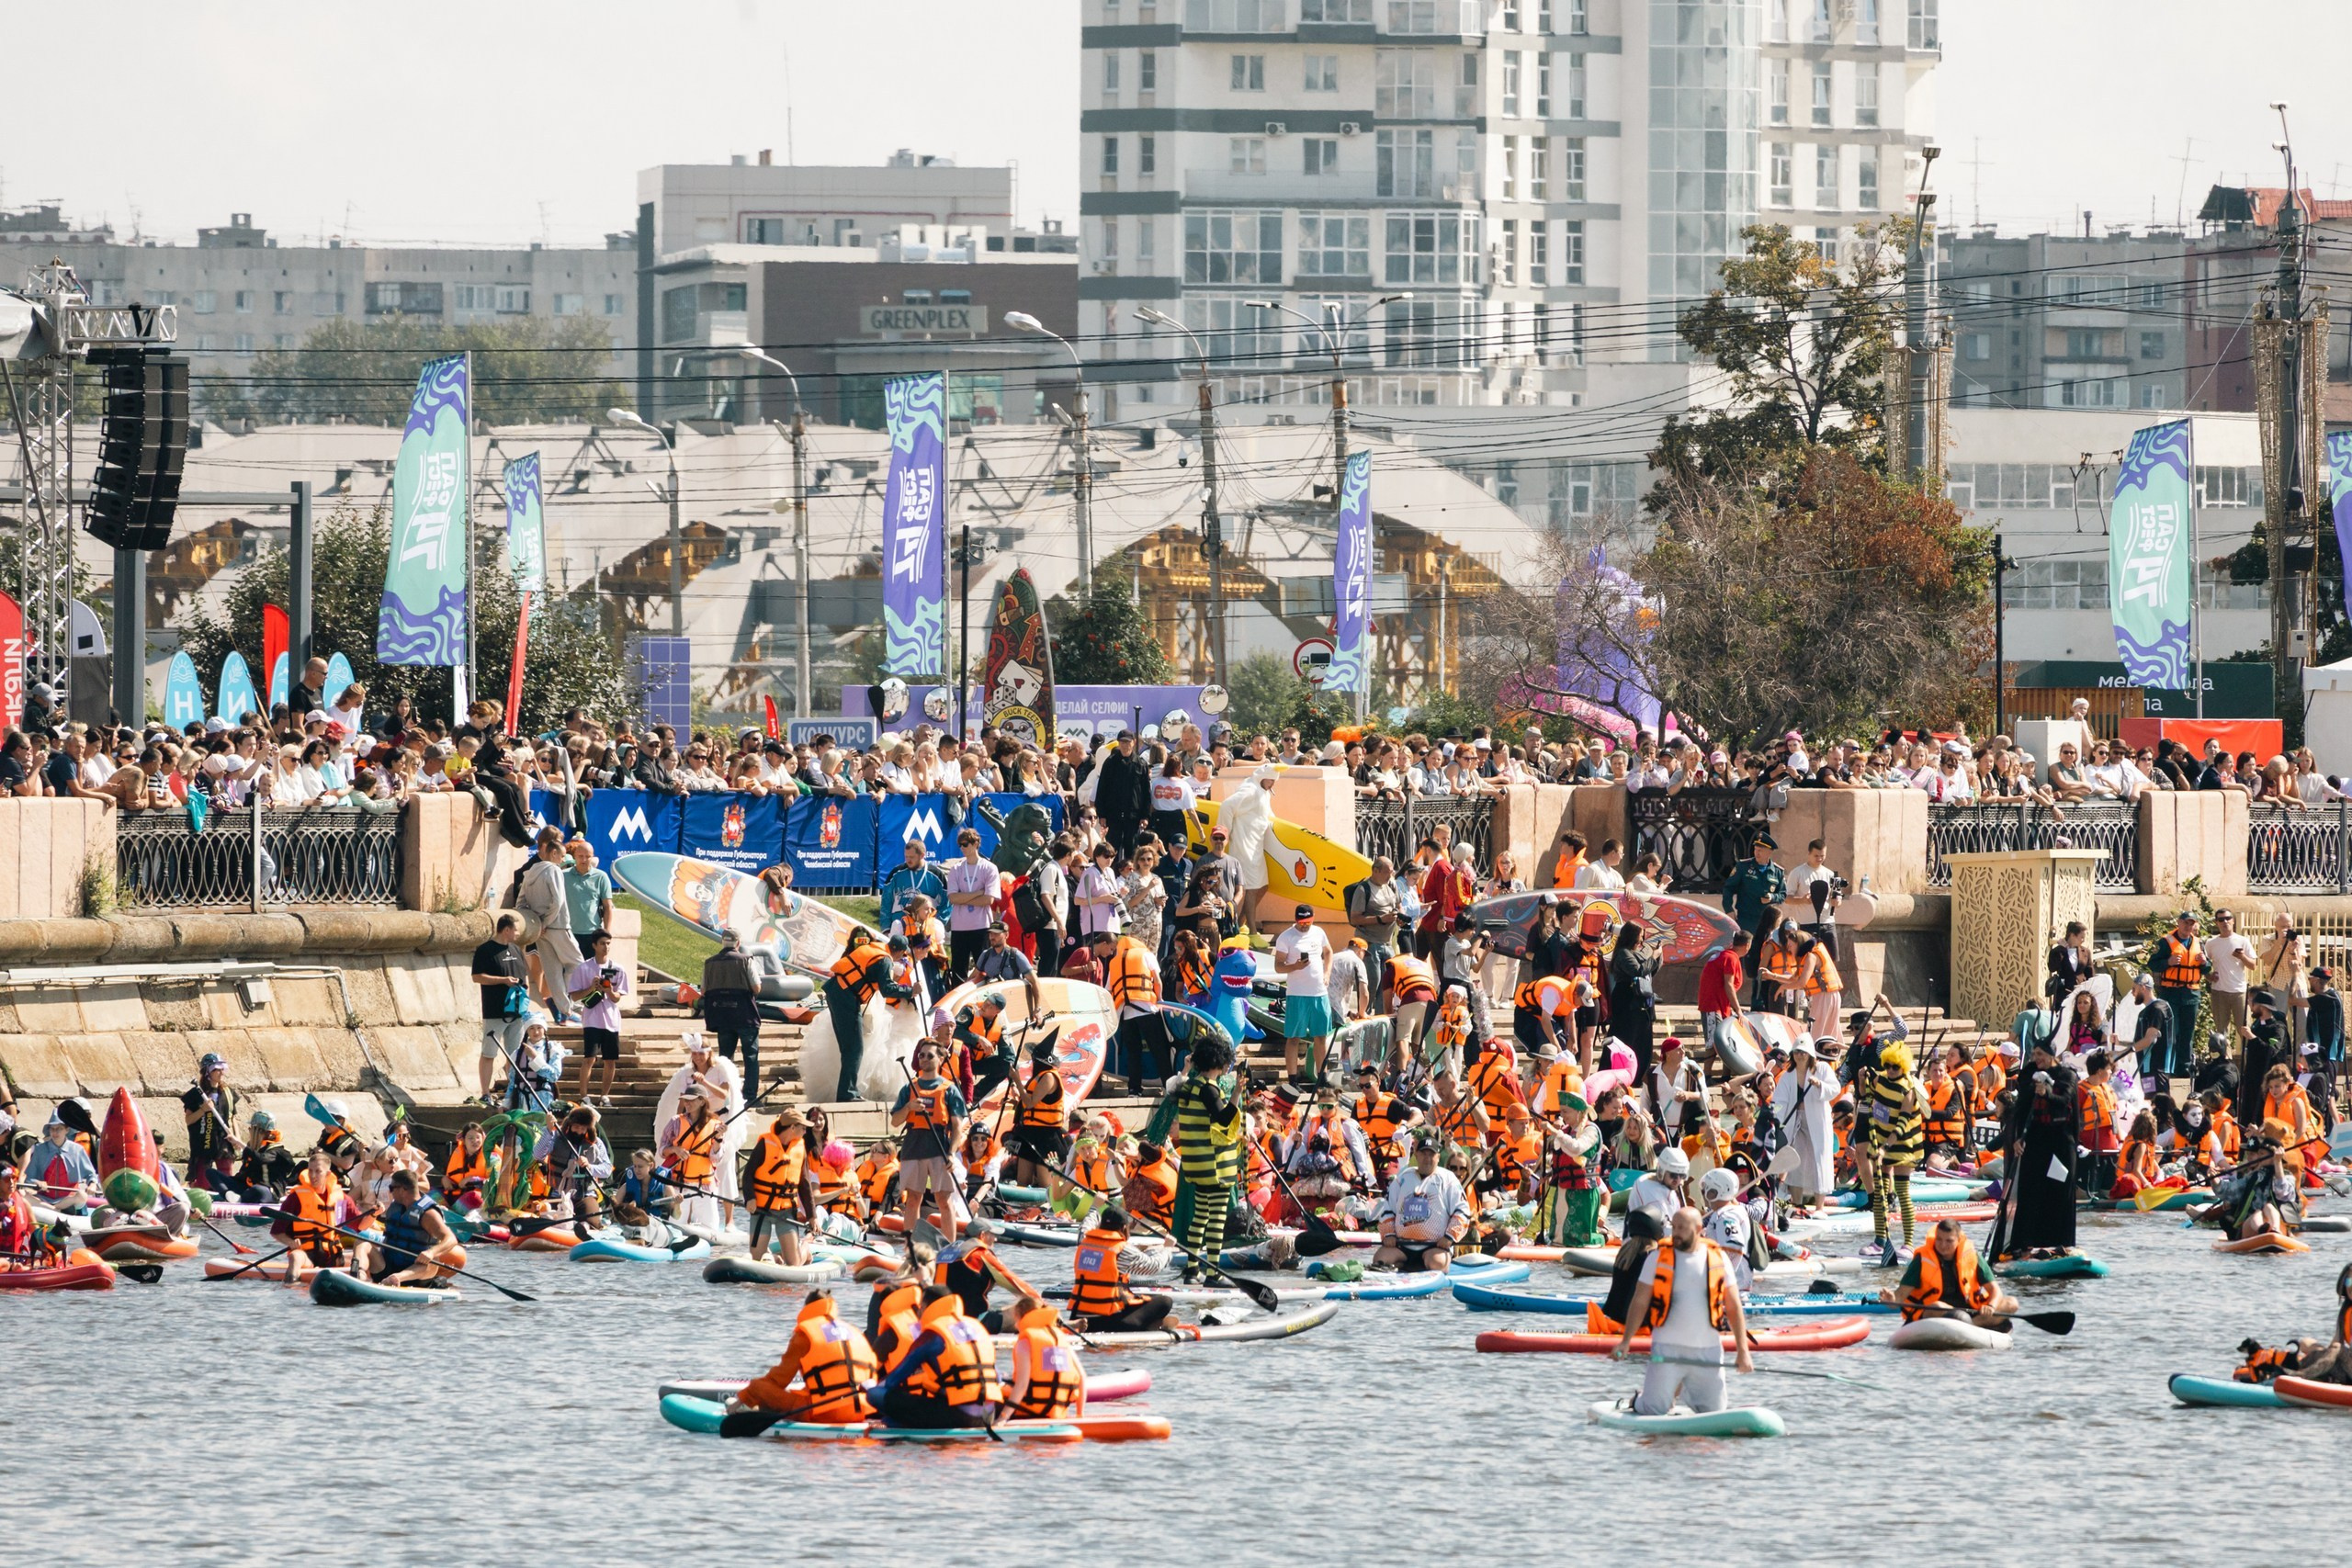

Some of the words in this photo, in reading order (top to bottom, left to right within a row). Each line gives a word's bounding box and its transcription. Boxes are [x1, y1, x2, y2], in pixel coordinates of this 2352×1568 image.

[871, 310, 970, 330] GREENPLEX
[1055, 698, 1088, 715] ДЕЛАЙ
[1091, 701, 1128, 715] СЕЛФИ!
[1002, 707, 1023, 718] BUCK
[1023, 709, 1042, 728] TEETH
[695, 847, 707, 858] При
[706, 850, 734, 859] поддержке
[733, 850, 768, 862] Губернатора
[797, 850, 807, 860] При
[831, 851, 860, 861] Губернатора
[735, 860, 758, 870] области
[204, 1111, 214, 1150] ЗАВОДОВ
[1408, 1204, 1423, 1213] 1944
